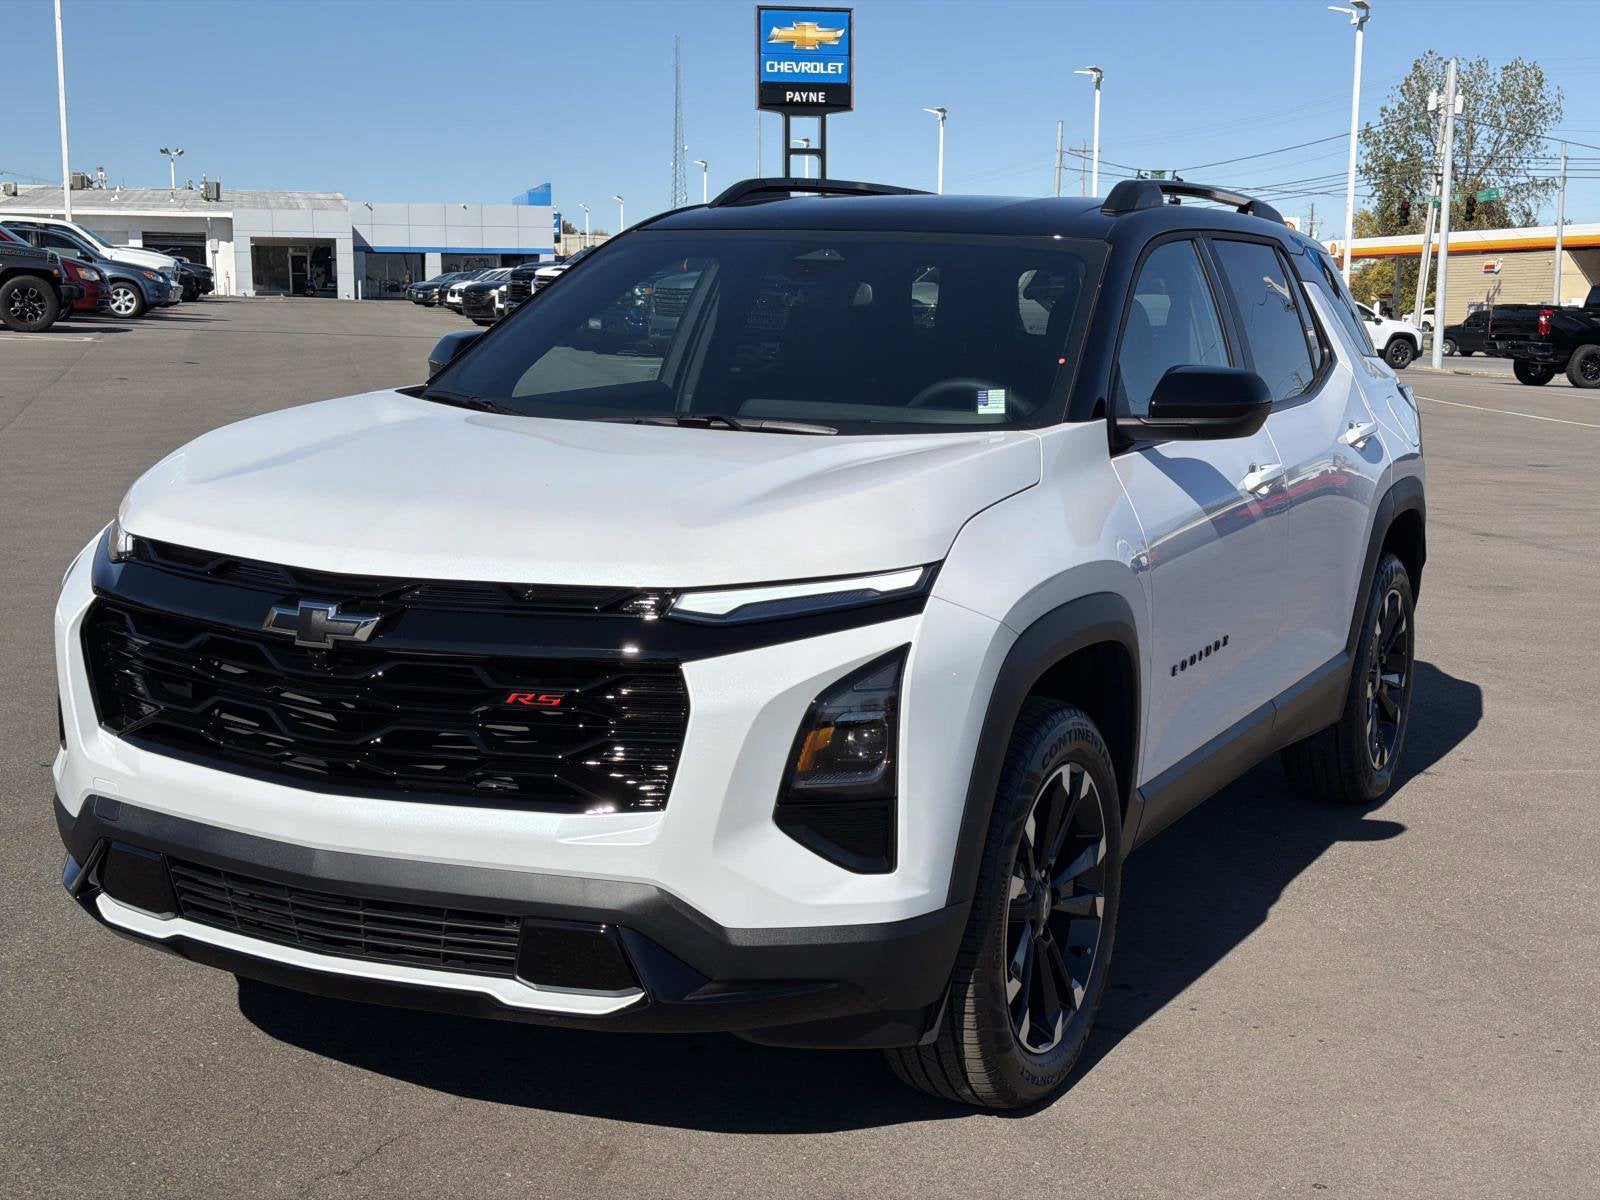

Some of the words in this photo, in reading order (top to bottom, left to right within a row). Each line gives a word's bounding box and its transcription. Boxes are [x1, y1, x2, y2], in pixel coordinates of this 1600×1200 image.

[765, 61, 845, 75] CHEVROLET
[785, 90, 827, 104] PAYNE
[505, 692, 566, 706] RS
